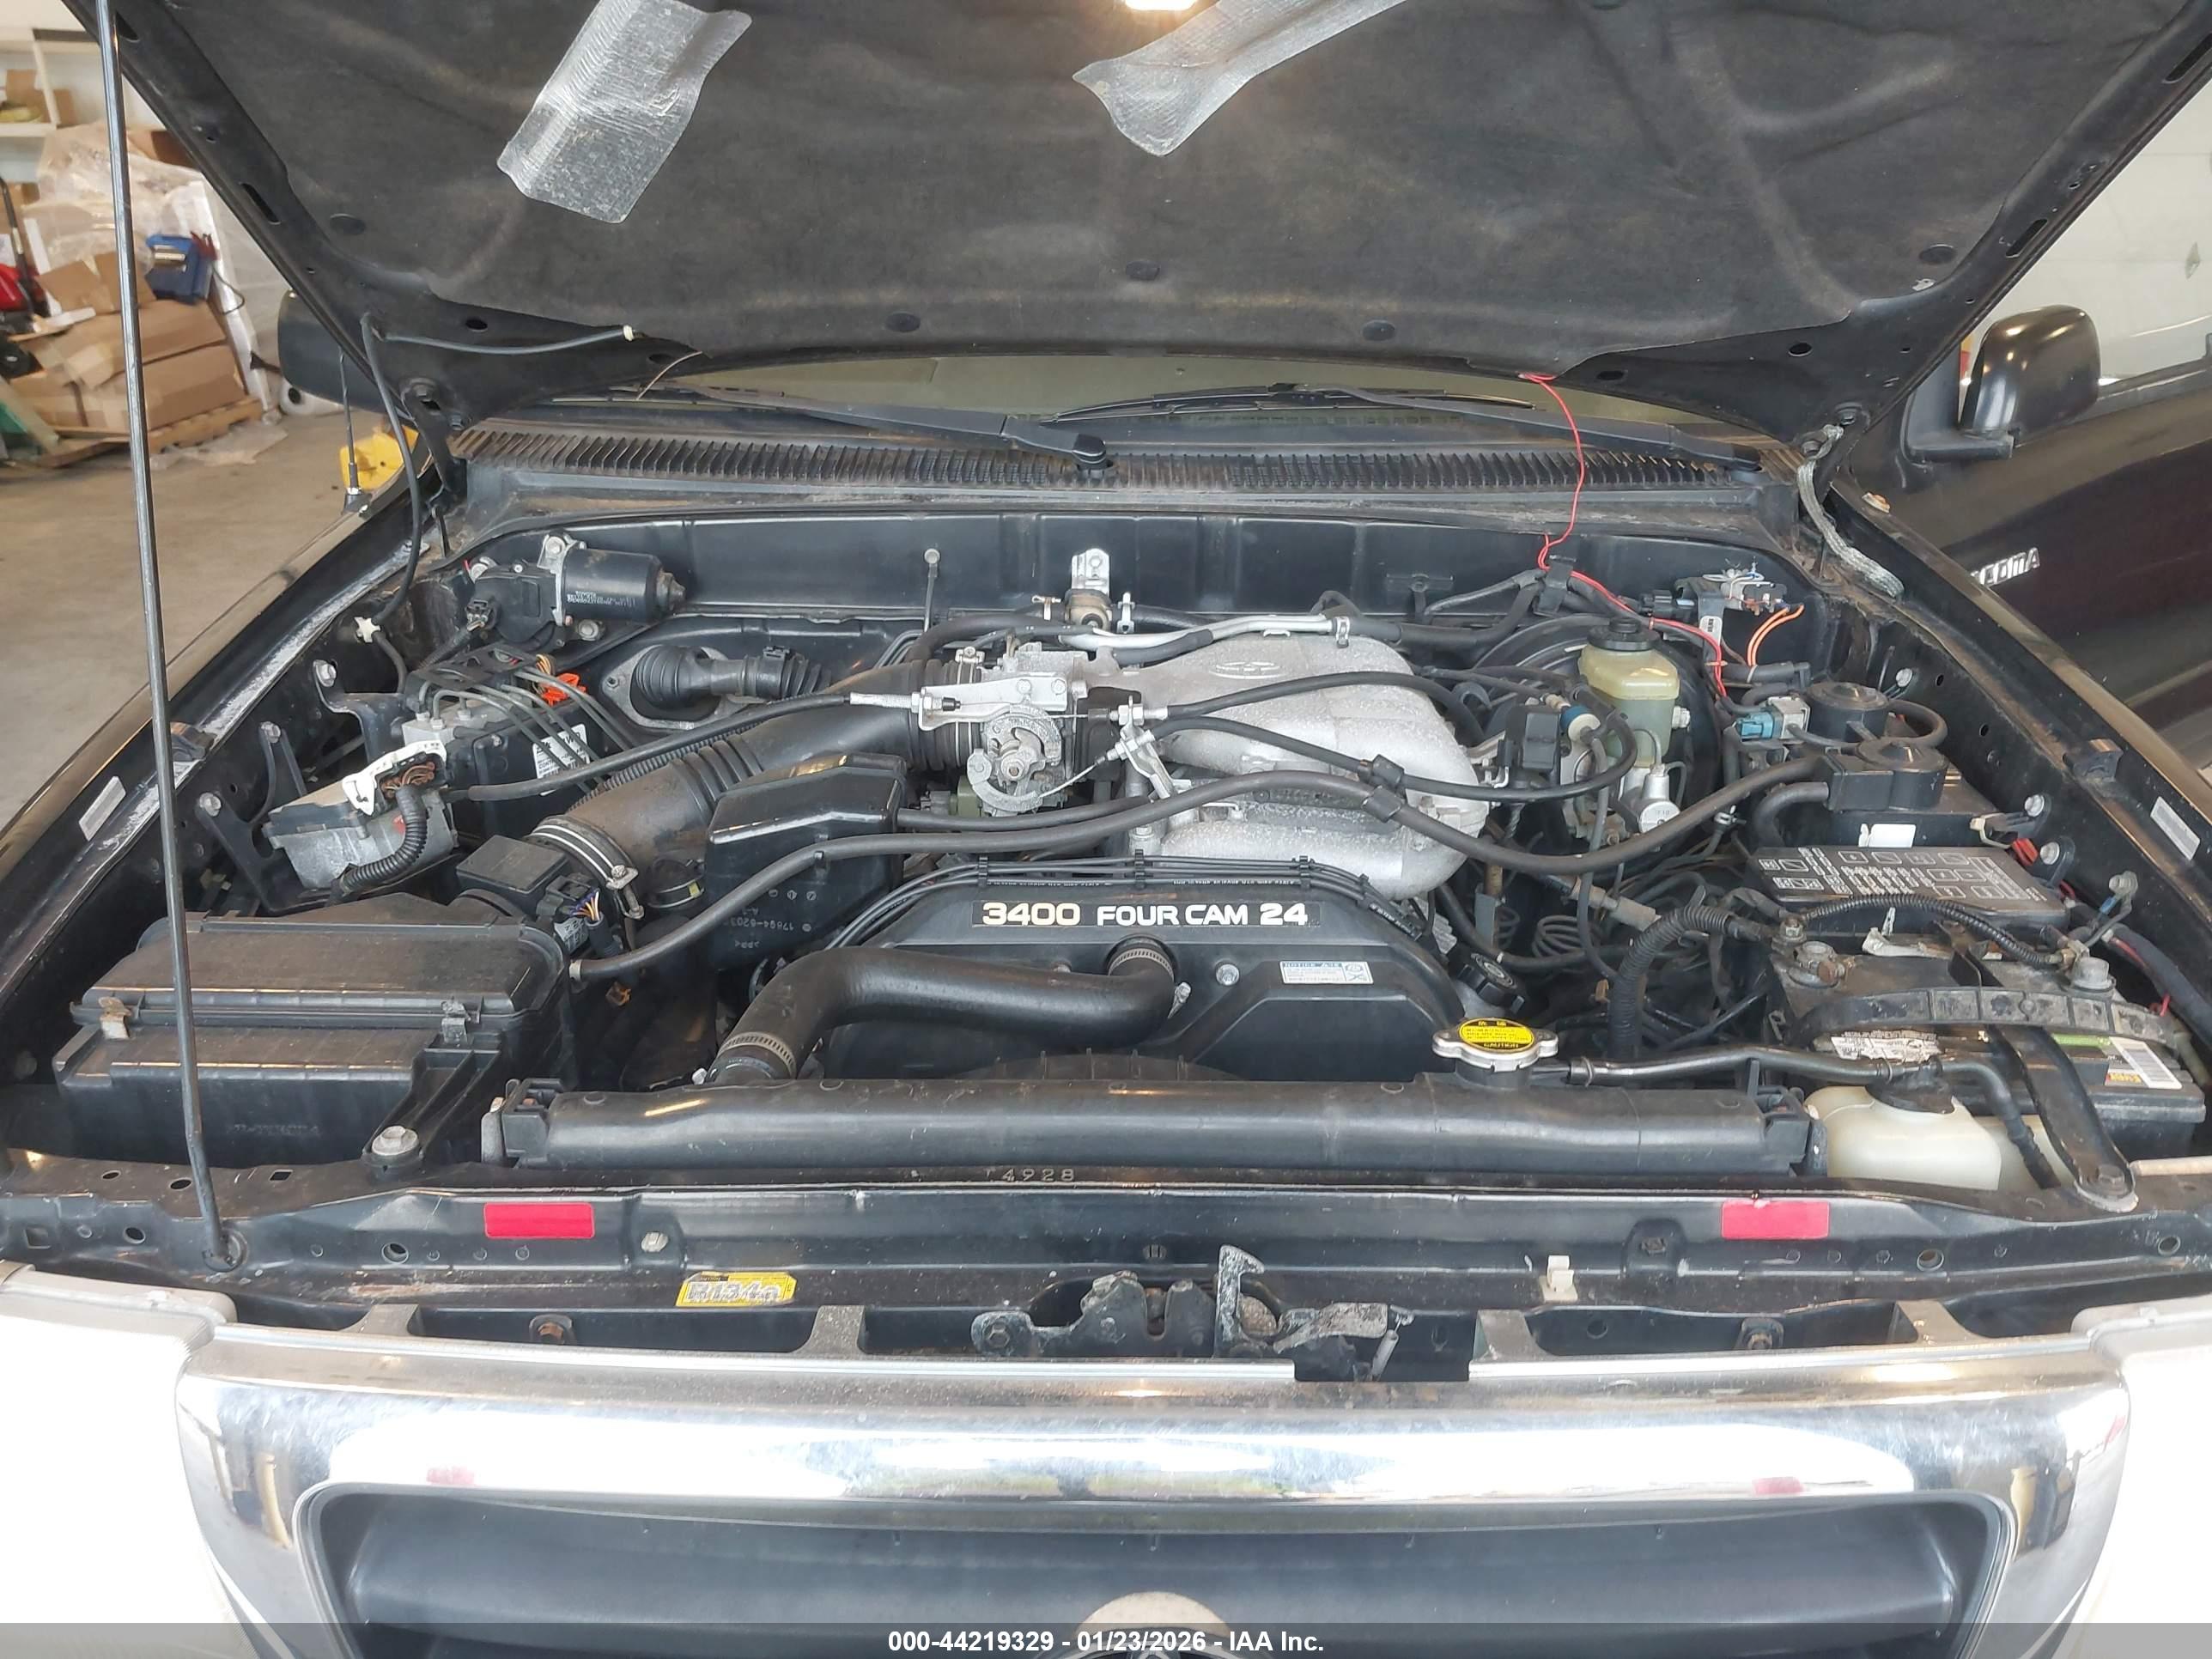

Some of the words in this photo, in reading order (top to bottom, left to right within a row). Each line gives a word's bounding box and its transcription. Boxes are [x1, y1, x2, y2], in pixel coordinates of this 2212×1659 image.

[1970, 546, 2040, 587] COMA
[982, 902, 1081, 927] 3400
[1097, 905, 1180, 927] FOUR
[1185, 904, 1249, 926] CAM
[1259, 902, 1309, 926] 24
